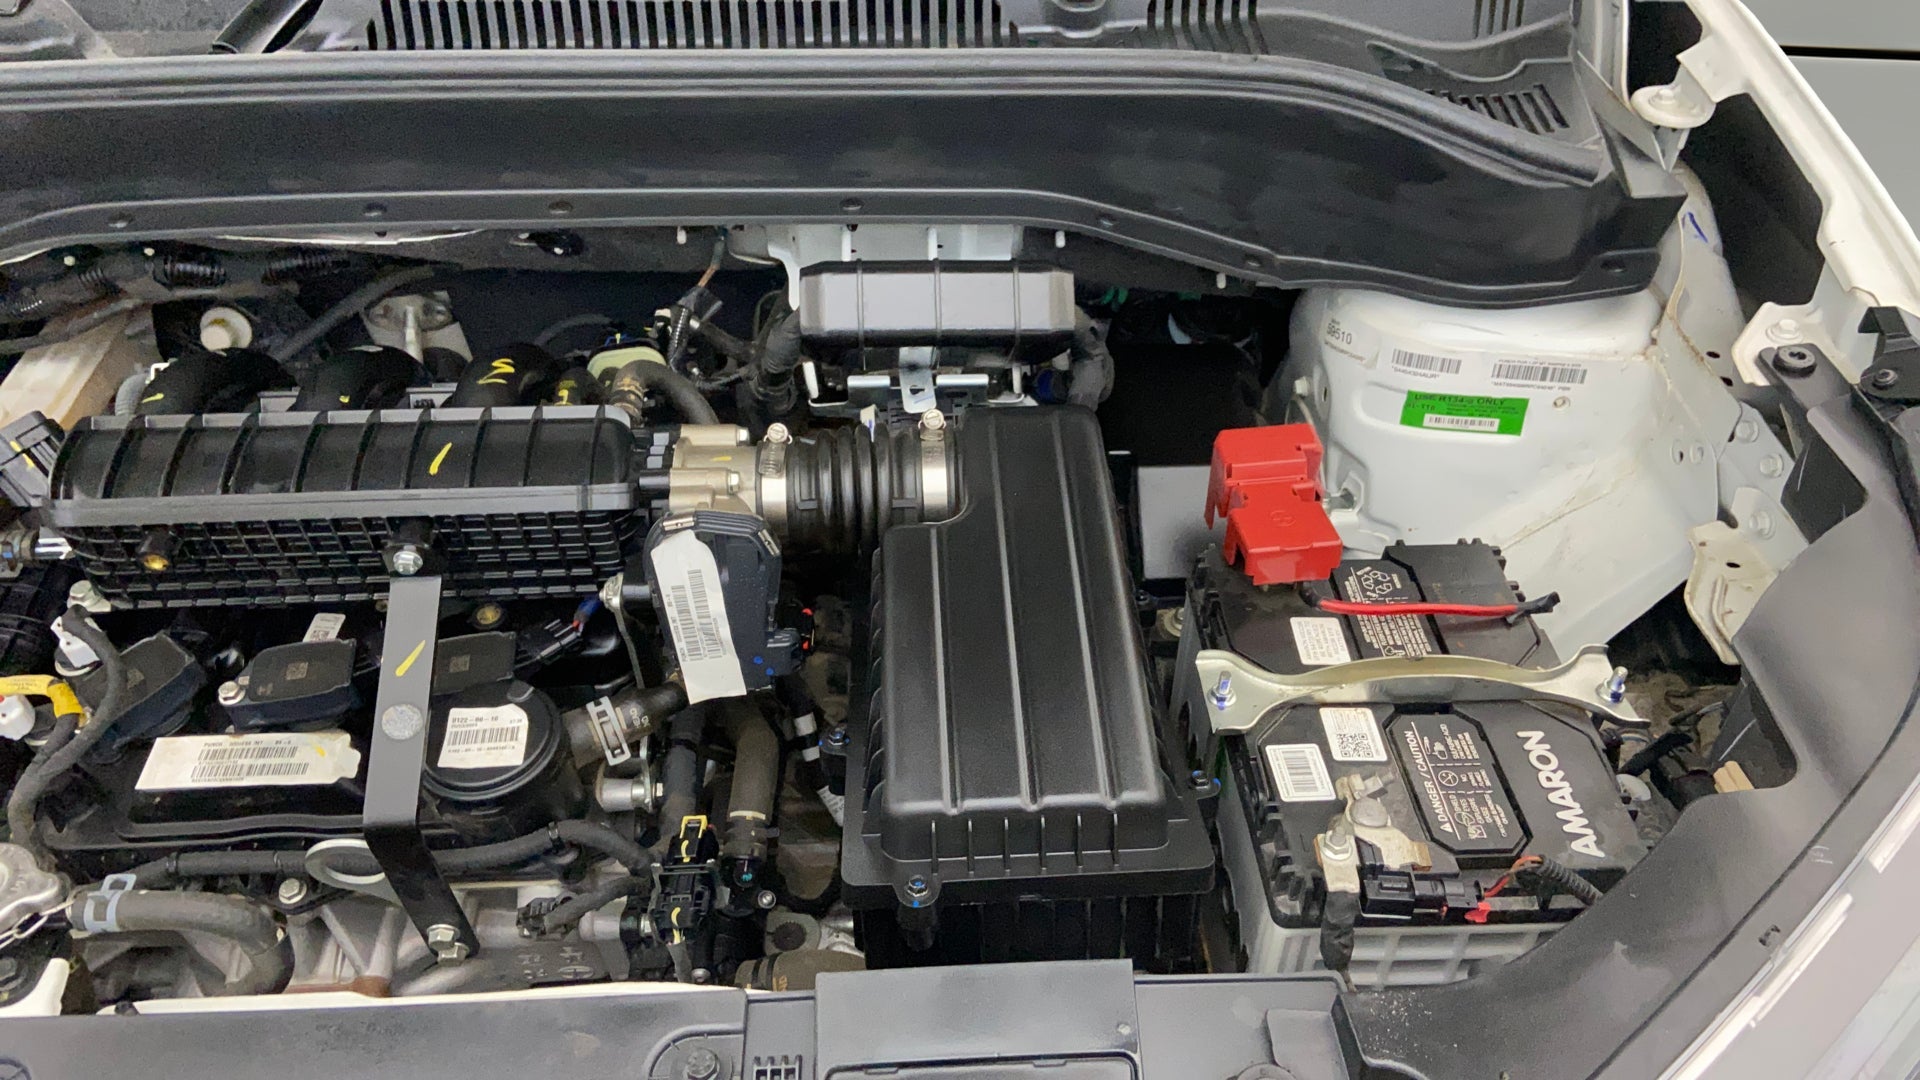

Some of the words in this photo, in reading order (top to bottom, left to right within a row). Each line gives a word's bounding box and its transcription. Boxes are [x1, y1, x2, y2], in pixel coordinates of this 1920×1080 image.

[1476, 396, 1505, 406] ONLY
[1403, 730, 1428, 771] CAUTION
[1422, 780, 1448, 821] DANGER
[1448, 794, 1461, 811] SHIELD
[1459, 798, 1470, 811] EYES
[1516, 730, 1605, 858] AMARON
